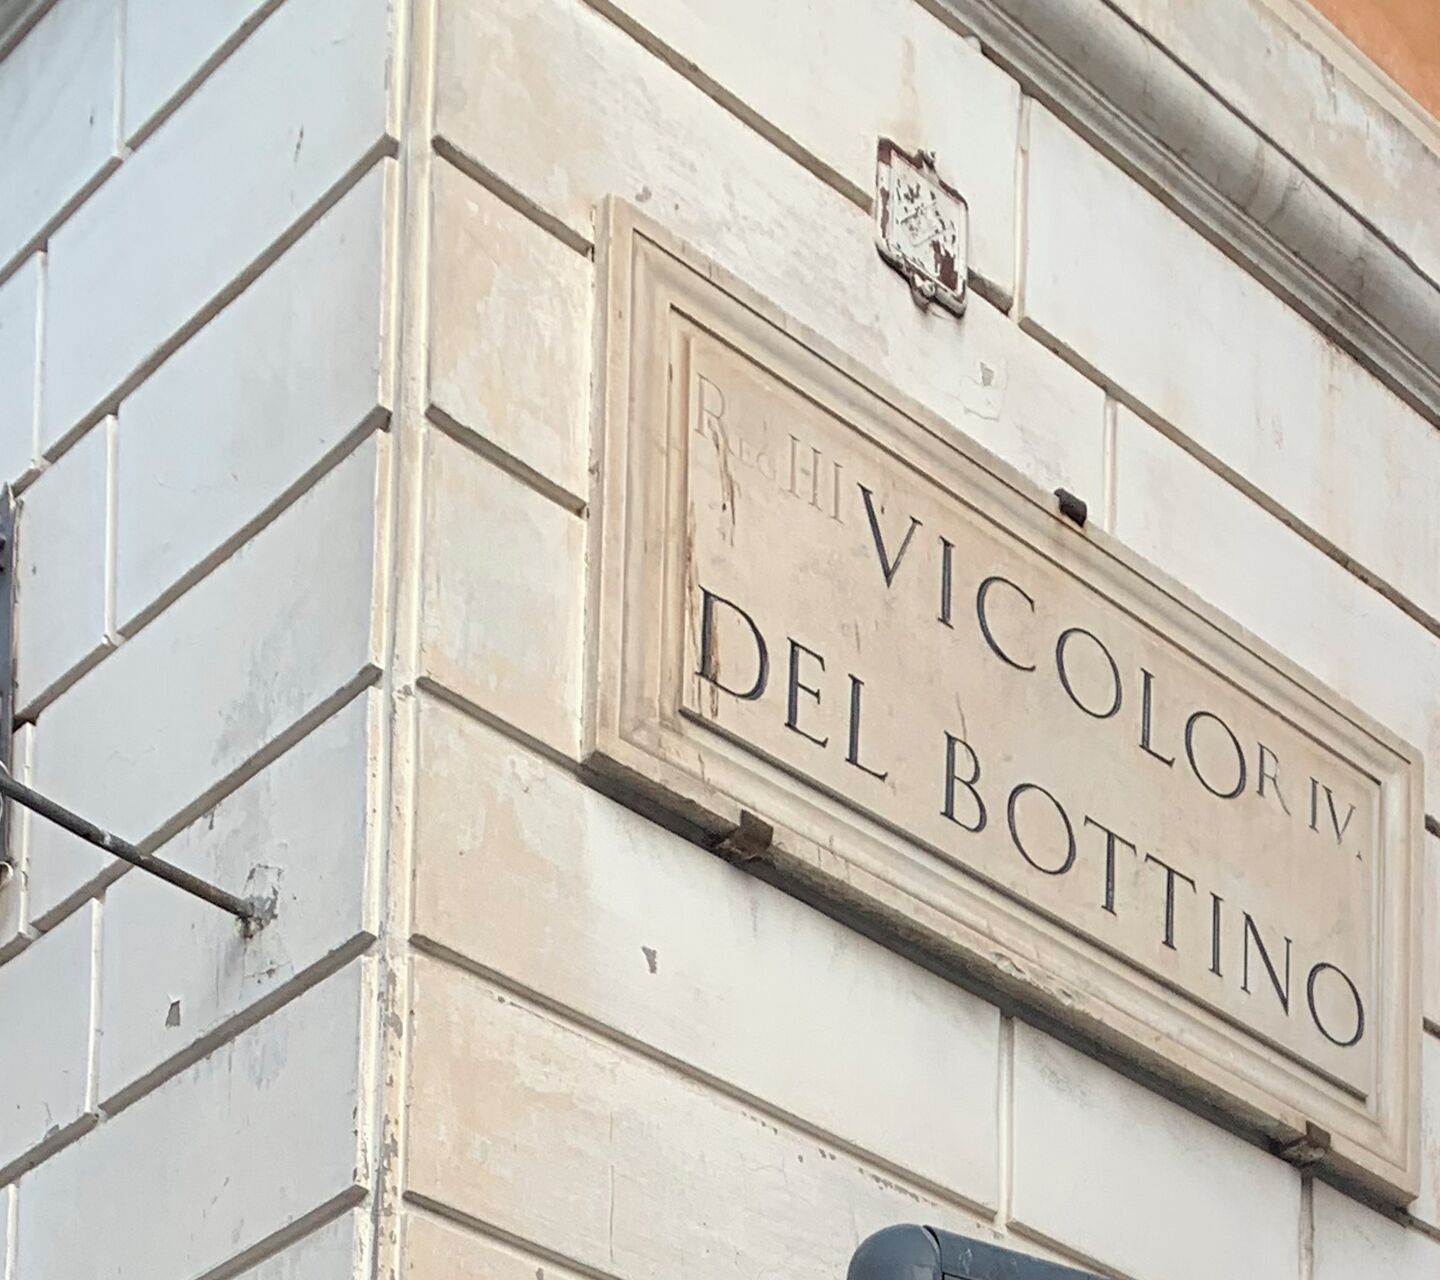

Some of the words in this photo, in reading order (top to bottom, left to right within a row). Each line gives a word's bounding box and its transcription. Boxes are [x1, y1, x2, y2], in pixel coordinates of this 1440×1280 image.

[694, 584, 889, 783] DEL
[938, 729, 1366, 1048] BOTTINO
[856, 482, 1248, 800] VICOLO
